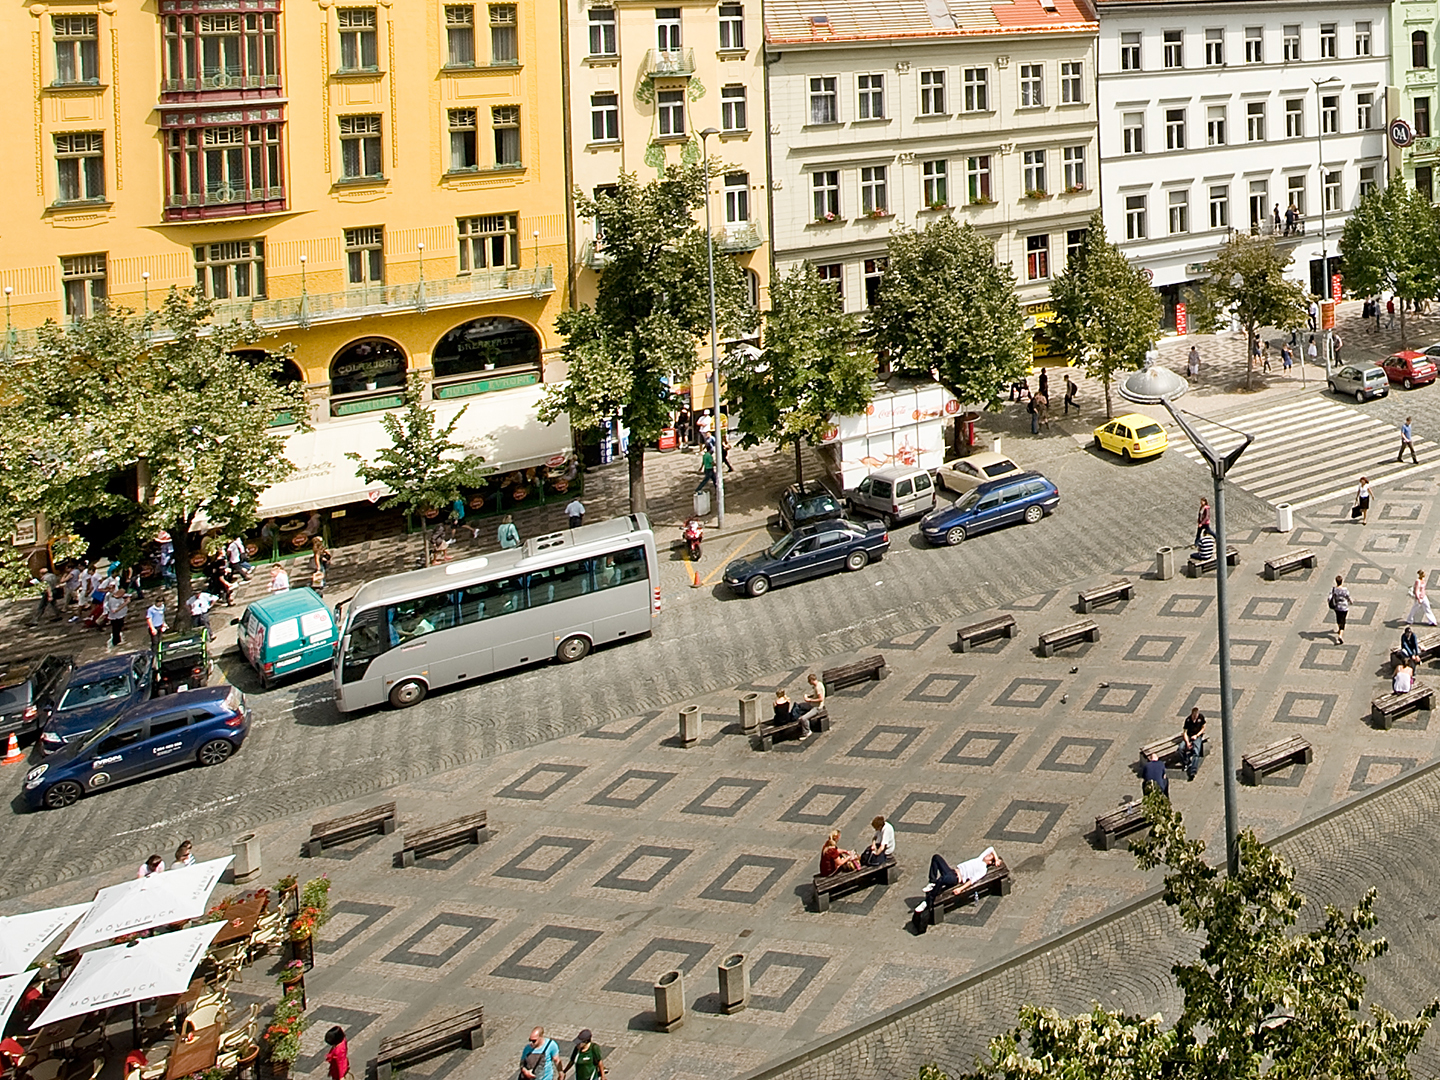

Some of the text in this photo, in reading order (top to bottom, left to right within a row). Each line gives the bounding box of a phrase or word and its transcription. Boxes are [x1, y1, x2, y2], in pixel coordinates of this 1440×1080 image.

[1028, 303, 1051, 314] CHA
[95, 909, 176, 935] MÖVENPICK
[70, 981, 157, 1009] MÖVENPICK
